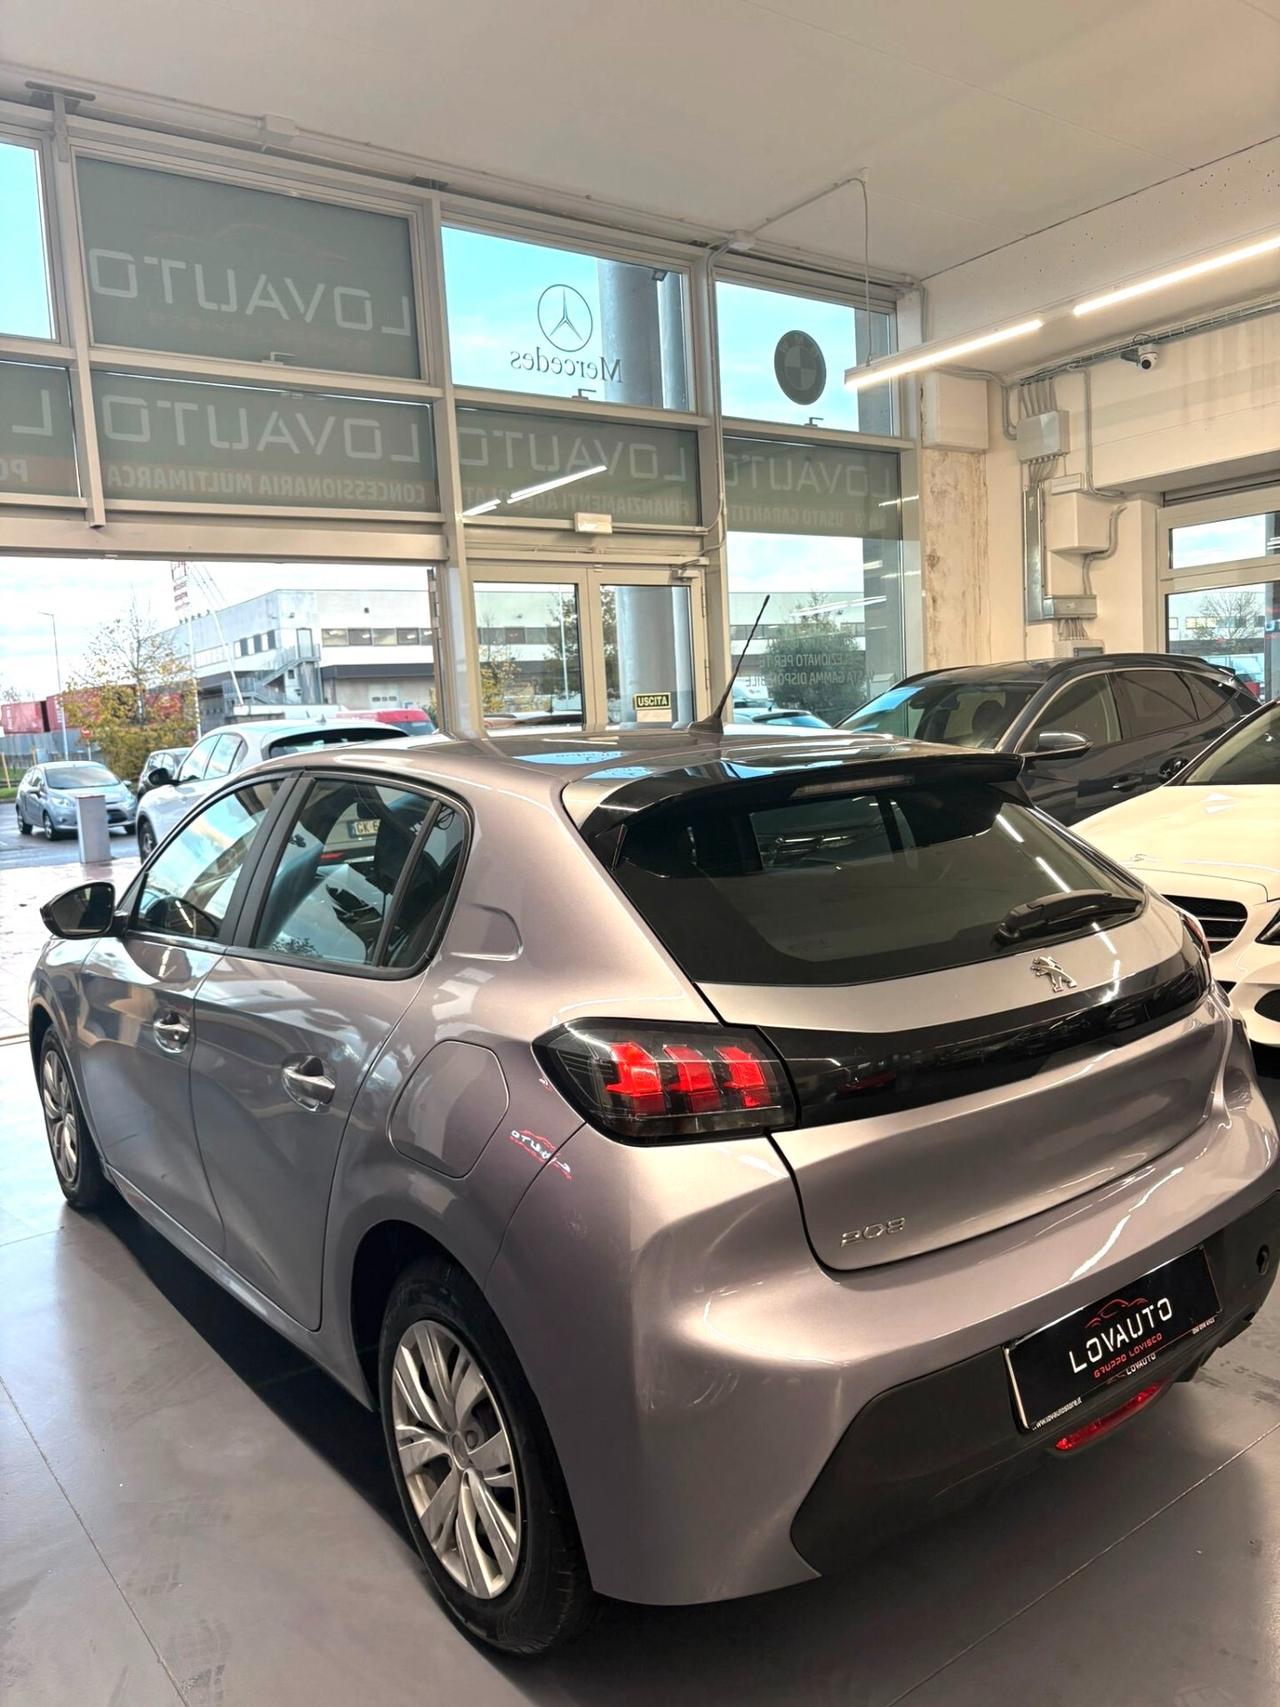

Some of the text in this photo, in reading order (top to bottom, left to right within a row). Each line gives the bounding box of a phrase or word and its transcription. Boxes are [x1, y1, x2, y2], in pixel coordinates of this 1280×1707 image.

[637, 695, 668, 707] USCITA
[1068, 1297, 1173, 1375] LOVAUTO
[1093, 1331, 1164, 1379] GRUPPO LOVISCO
[1125, 1352, 1157, 1376] LOVAUTO
